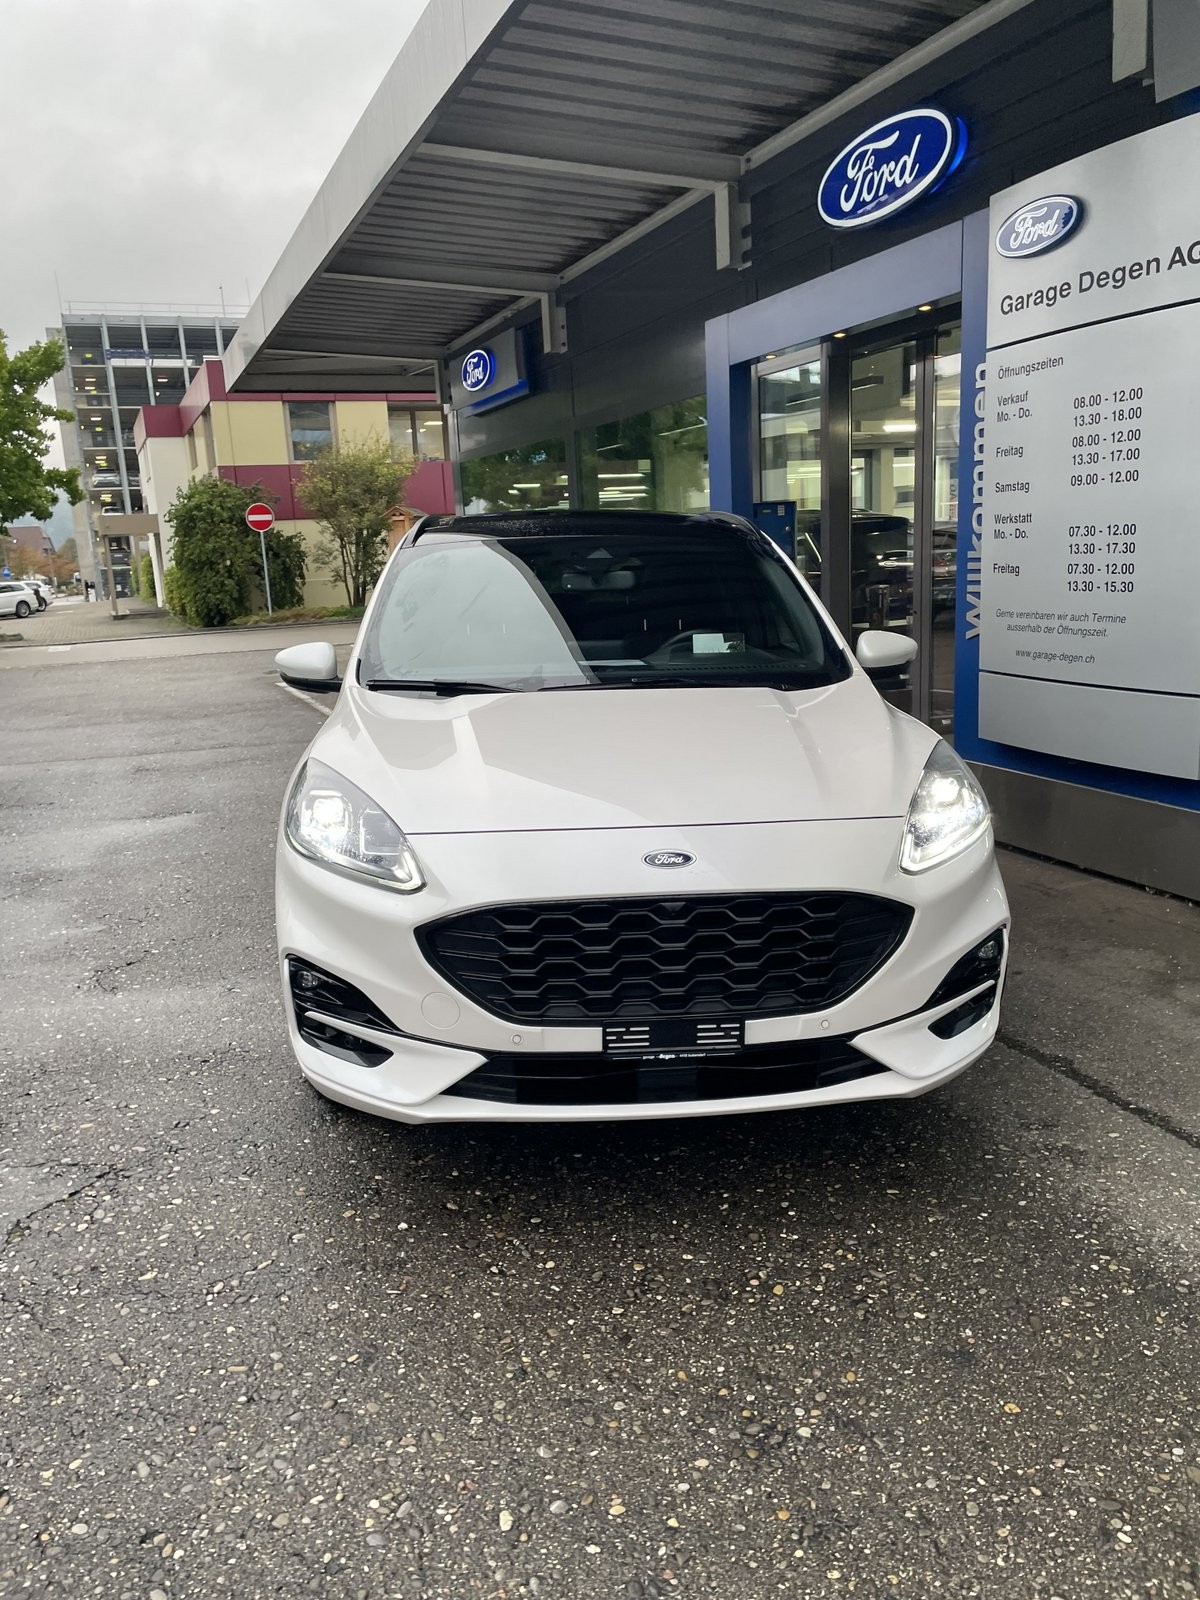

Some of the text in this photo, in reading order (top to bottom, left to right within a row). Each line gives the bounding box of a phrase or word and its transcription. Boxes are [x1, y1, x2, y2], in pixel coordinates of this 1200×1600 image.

[840, 131, 921, 212] Ford
[1010, 207, 1060, 249] Ford
[1000, 240, 1200, 315] Garage Degen AG
[466, 357, 483, 384] Ford
[998, 355, 1064, 380] Öffnungszeiten
[997, 391, 1028, 406] Verkauf
[1073, 394, 1101, 409] 08.00
[1112, 387, 1143, 403] 12.00
[997, 411, 1011, 422] Mo.
[1018, 407, 1032, 419] Do.
[1074, 412, 1101, 427] 13.30
[1112, 406, 1142, 422] 18.00
[1072, 433, 1100, 448] 08.00
[1111, 428, 1141, 444] 12.00
[996, 445, 1024, 458] Freitag
[1072, 452, 1099, 466] 13.30
[1110, 448, 1140, 462] 17.00
[1070, 473, 1098, 486] 09.00
[1109, 469, 1139, 483] 12.00
[995, 480, 1030, 494] Samstag
[994, 512, 1032, 524] Werkstatt
[994, 529, 1007, 540] Mo.
[1014, 528, 1029, 539] Do.
[1068, 525, 1096, 537] 07.30
[1106, 524, 1137, 536] 12.00
[1068, 543, 1095, 555] 13.30
[1106, 542, 1136, 554] 17.30
[993, 563, 1020, 576] Freitag
[1067, 563, 1095, 575] 07.30
[1105, 563, 1135, 575] 12.00
[1067, 581, 1094, 592] 13.30
[1104, 581, 1134, 593] 15.30
[995, 608, 1127, 623] Gerne vereinbaren wir auch Termine
[1007, 623, 1042, 633] ausserhalb
[1043, 625, 1056, 634] der
[1015, 649, 1095, 664] www.garage-degen.ch
[654, 853, 684, 864] Ford
